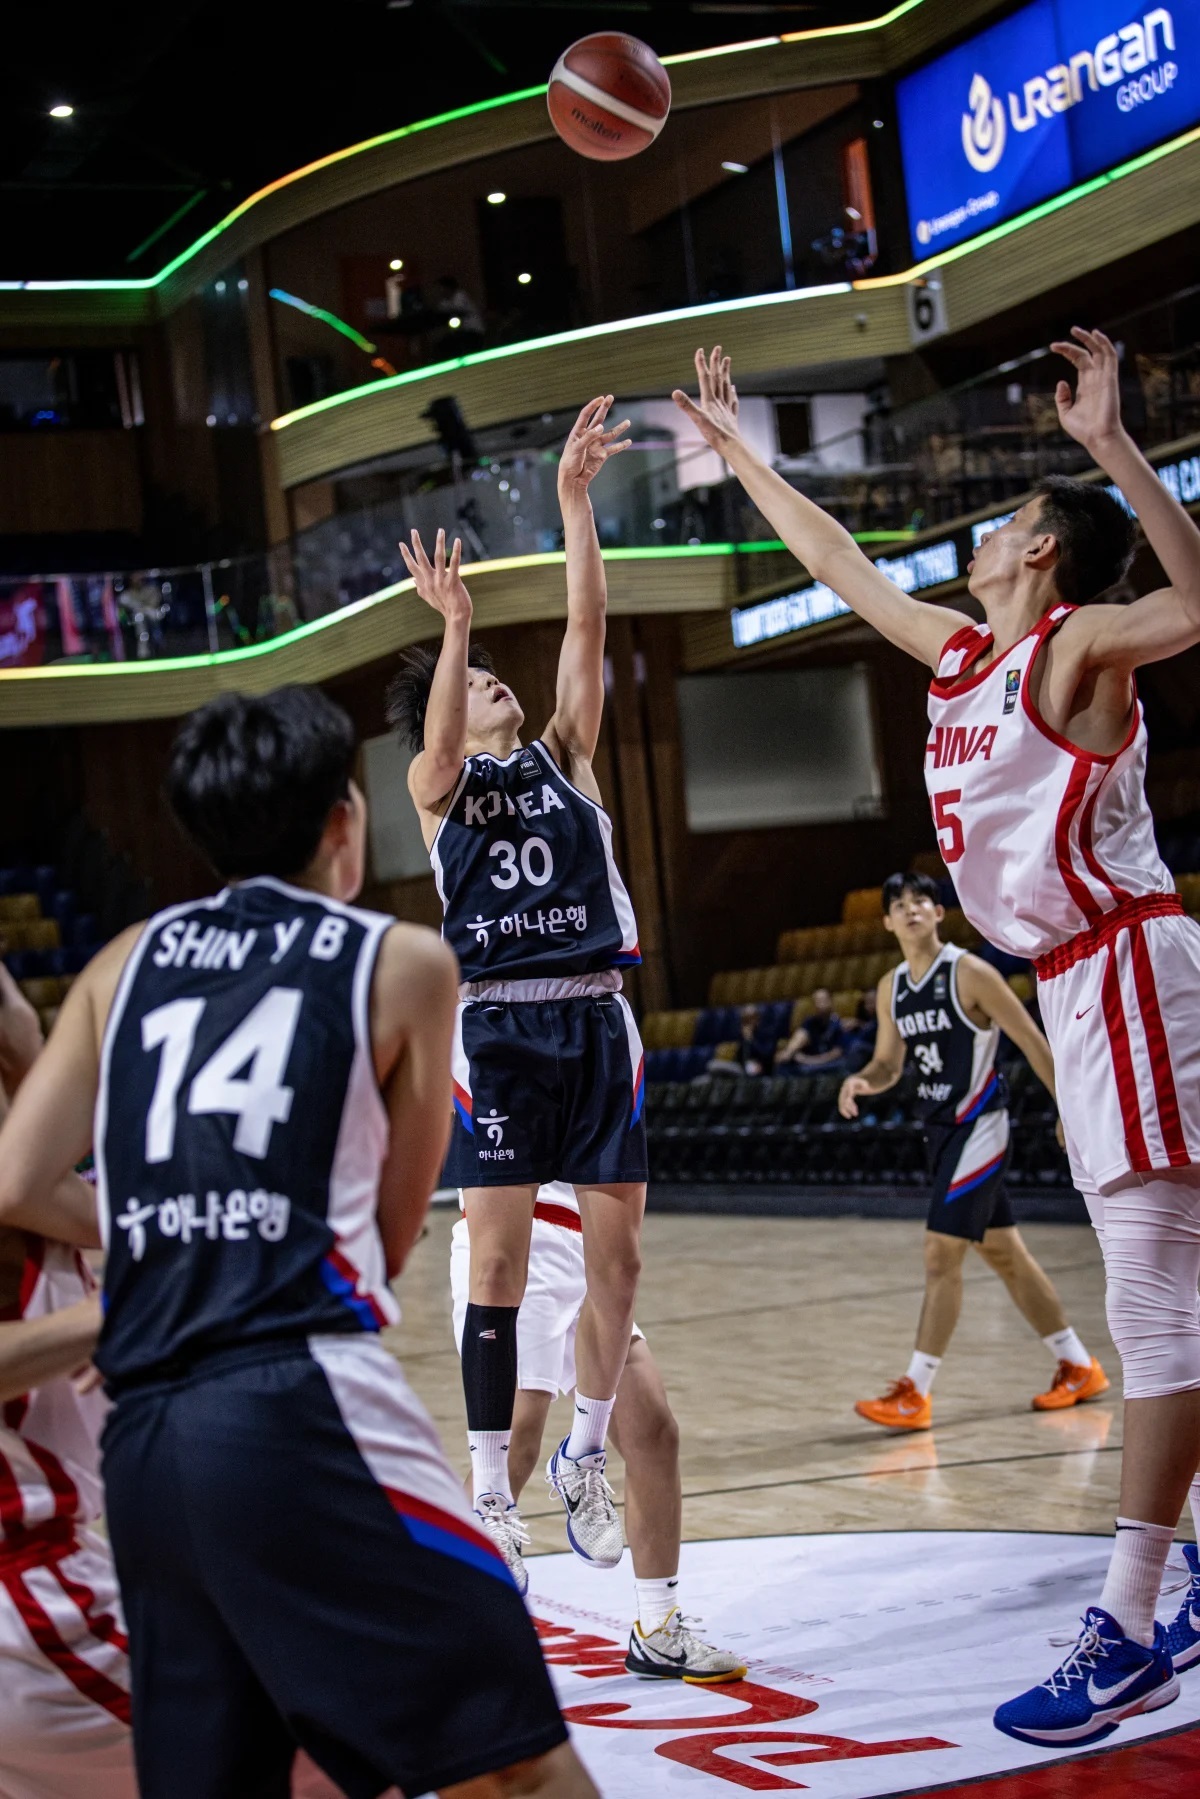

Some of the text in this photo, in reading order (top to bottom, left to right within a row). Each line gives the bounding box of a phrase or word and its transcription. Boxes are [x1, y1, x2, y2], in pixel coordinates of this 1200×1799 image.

[1116, 61, 1178, 112] GROUP
[571, 107, 622, 141] molten
[924, 725, 999, 769] HINA
[929, 788, 966, 864] 5
[488, 836, 554, 890] 30
[152, 914, 349, 971] SHIN Y B
[499, 904, 587, 938] 하나은행
[896, 1008, 953, 1039] KOREA
[140, 986, 305, 1165] 14
[914, 1041, 944, 1076] 34
[478, 1148, 515, 1161] 하나은행
[157, 1189, 291, 1244] 하나은행
